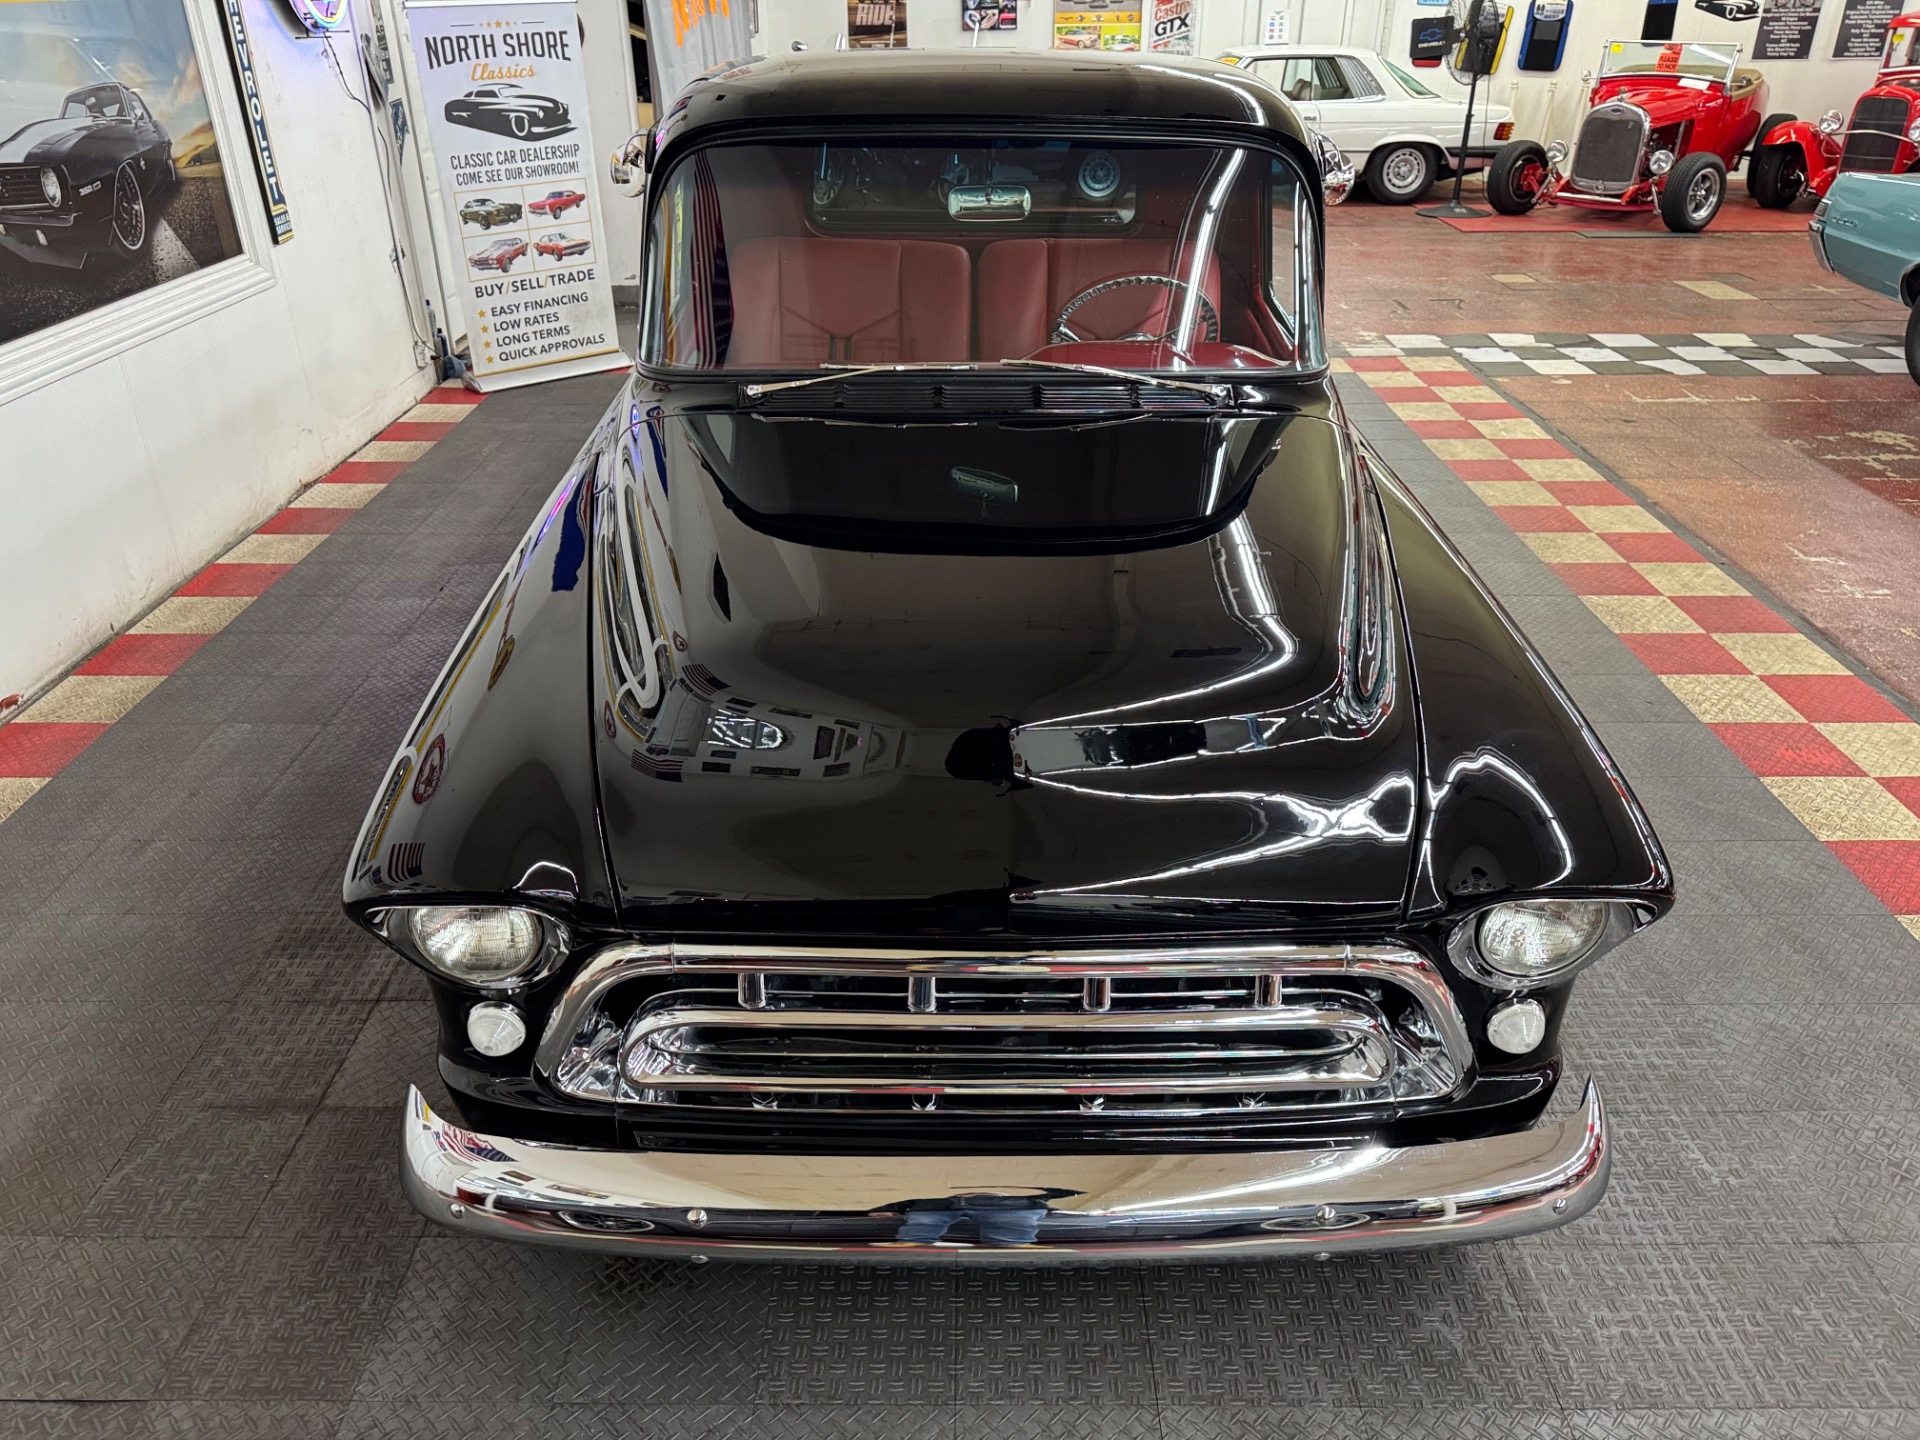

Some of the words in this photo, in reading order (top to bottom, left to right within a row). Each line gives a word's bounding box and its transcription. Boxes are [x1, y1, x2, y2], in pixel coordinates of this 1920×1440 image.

[856, 4, 894, 26] RIDE
[1155, 1, 1190, 21] Castro
[1155, 13, 1190, 36] GTX
[424, 34, 496, 70] NORTH
[503, 31, 571, 61] SHORE
[471, 63, 536, 81] Classics
[450, 152, 494, 170] CLASSIC
[496, 151, 517, 164] CAR
[520, 144, 580, 162] DEALERSHIP
[456, 171, 484, 186] COME
[486, 170, 501, 182] SEE
[505, 167, 524, 180] OUR
[526, 161, 580, 178] SHOWROOM!
[491, 303, 520, 317] EASY
[524, 292, 589, 312] FINANCING
[494, 318, 521, 332] LOW
[524, 312, 559, 327] RATES
[496, 333, 530, 347] LONG
[532, 325, 570, 340] TERMS
[499, 346, 537, 361] QUICK
[540, 334, 605, 354] APPROVALS
